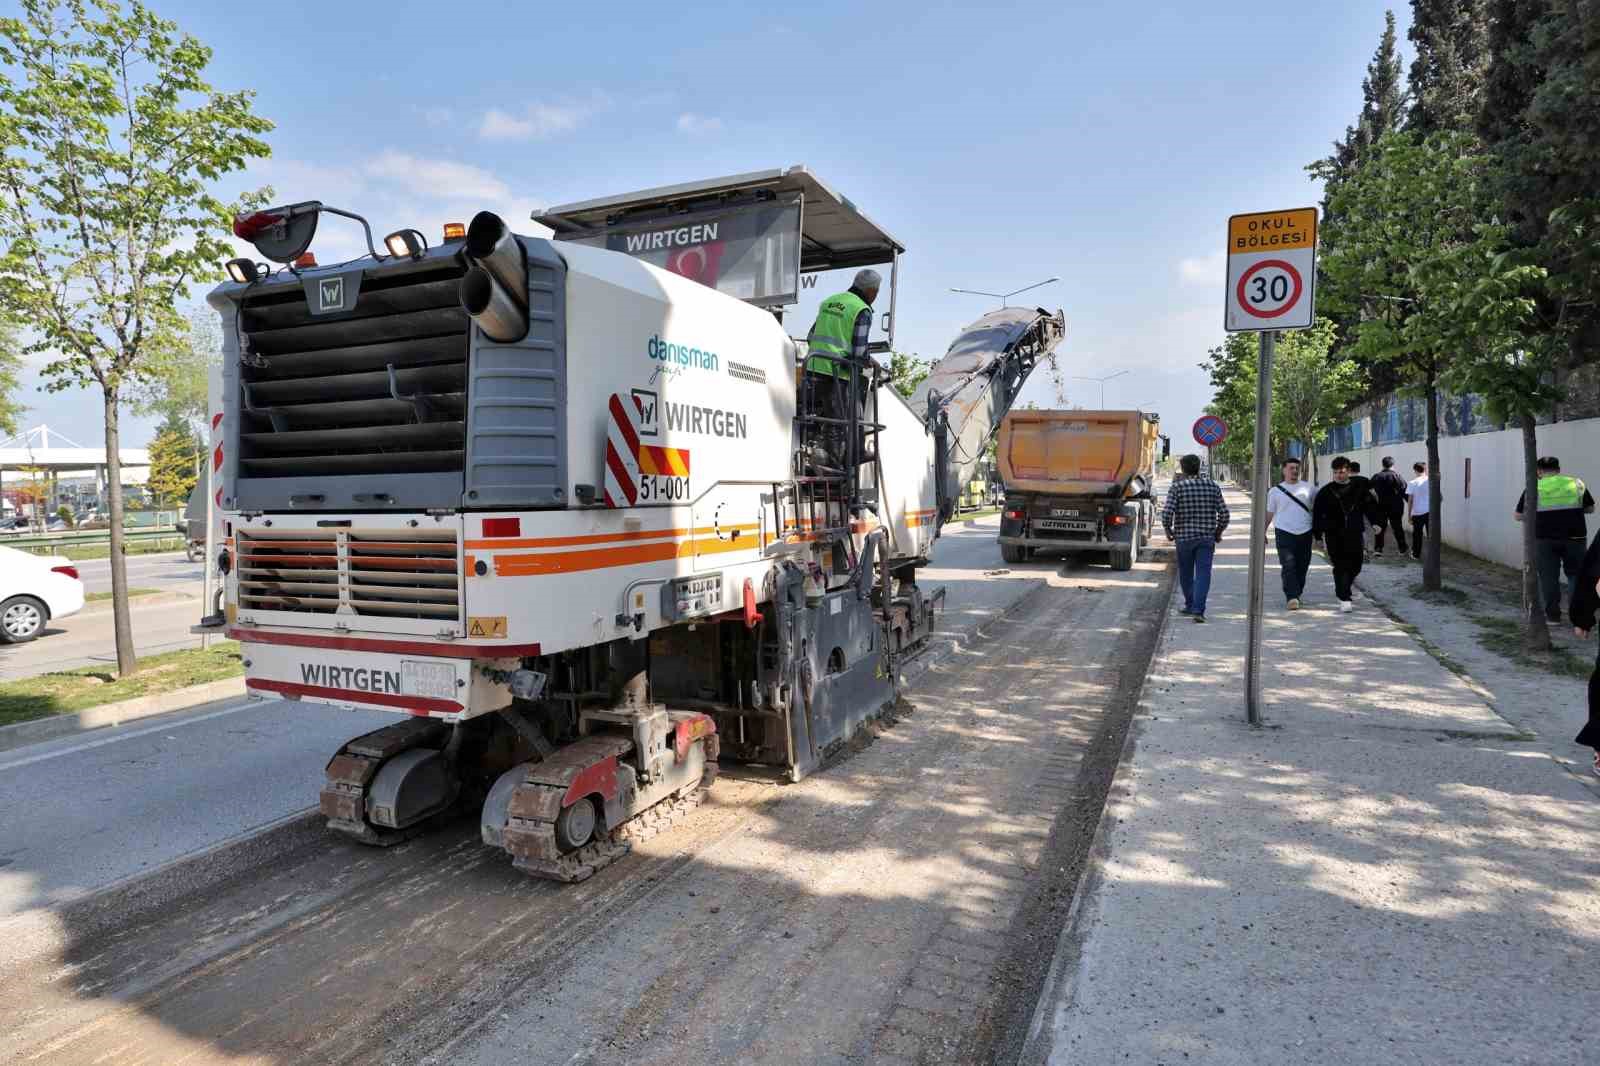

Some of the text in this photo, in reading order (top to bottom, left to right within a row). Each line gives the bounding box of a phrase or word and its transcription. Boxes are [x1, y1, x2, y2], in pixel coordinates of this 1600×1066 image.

[626, 223, 719, 251] WIRTGEN
[1248, 217, 1295, 232] OKUL
[1237, 229, 1307, 249] BÖLGESİ
[1250, 275, 1288, 303] 30
[665, 401, 747, 440] WIRTGEN
[640, 474, 690, 501] 51-001
[301, 663, 401, 695] WIRTGEN
